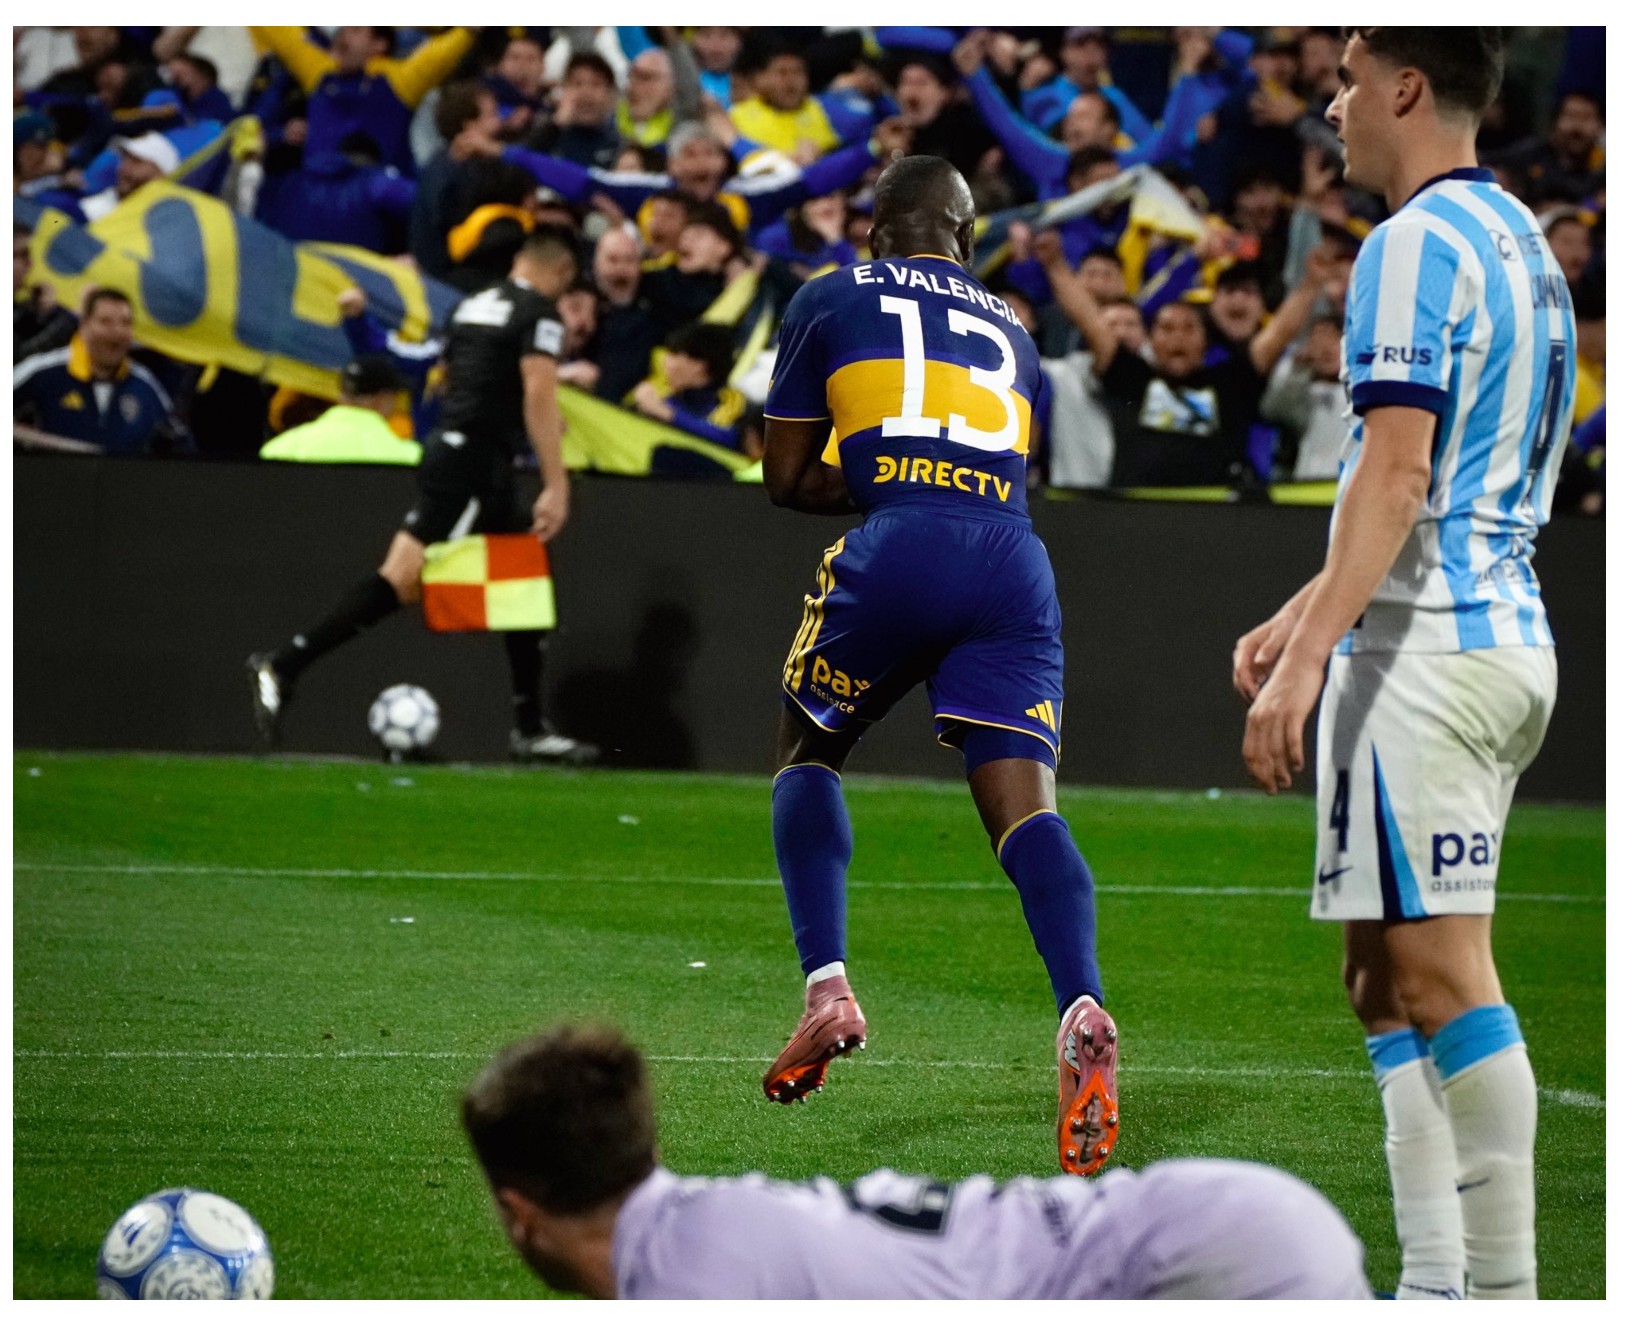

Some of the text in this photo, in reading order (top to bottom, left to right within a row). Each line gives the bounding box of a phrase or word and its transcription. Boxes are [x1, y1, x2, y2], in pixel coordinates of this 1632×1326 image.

[853, 262, 1028, 333] E. VALENCIA
[880, 294, 1020, 453] 13
[1383, 346, 1432, 366] RUS
[873, 455, 1012, 503] DIRECTV
[1329, 769, 1350, 852] 4
